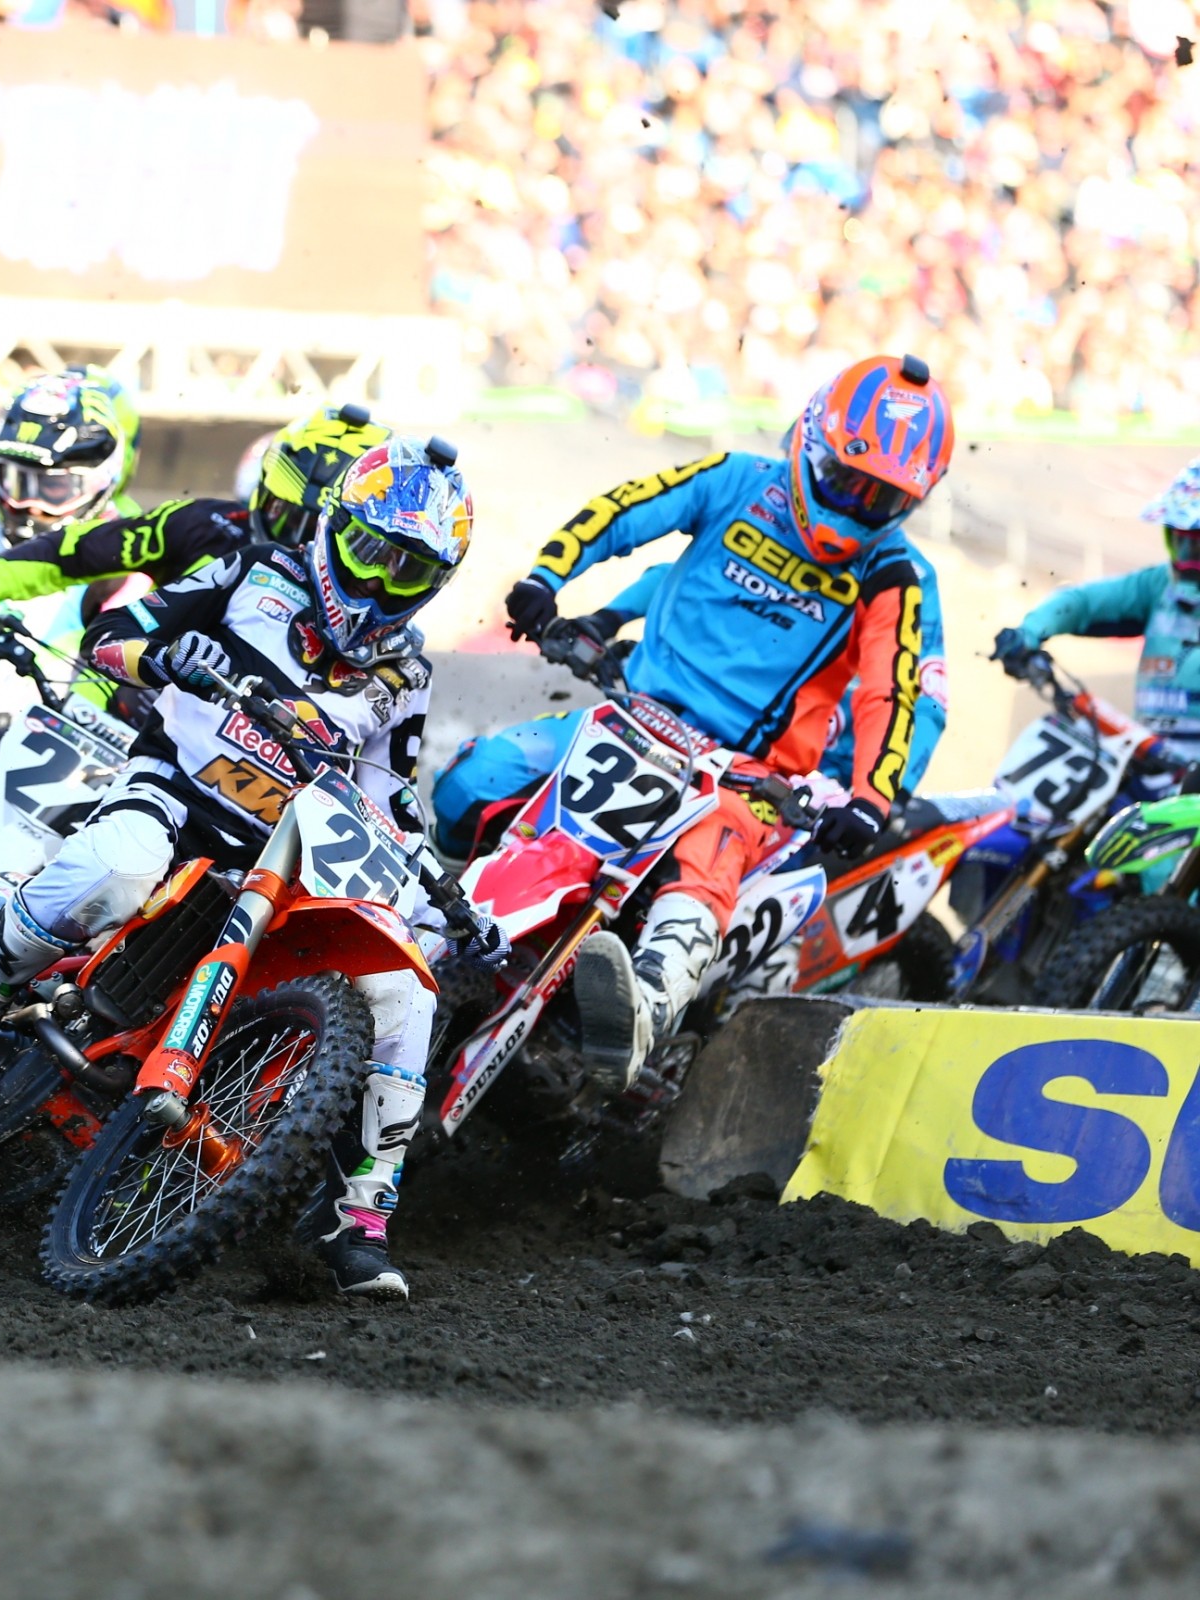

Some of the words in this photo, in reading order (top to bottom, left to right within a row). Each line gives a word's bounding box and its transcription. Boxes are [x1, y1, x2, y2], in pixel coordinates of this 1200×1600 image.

[270, 576, 312, 607] MOTORE
[723, 520, 860, 606] GEICO
[724, 560, 825, 622] HONDA
[560, 742, 681, 850] 32
[1003, 730, 1110, 822] 73
[310, 812, 410, 908] 25
[845, 867, 904, 943] 4
[697, 897, 784, 1000] 32
[167, 983, 204, 1049] MOTOREX
[465, 1021, 527, 1105] DUNLOP
[944, 1038, 1200, 1232] S
